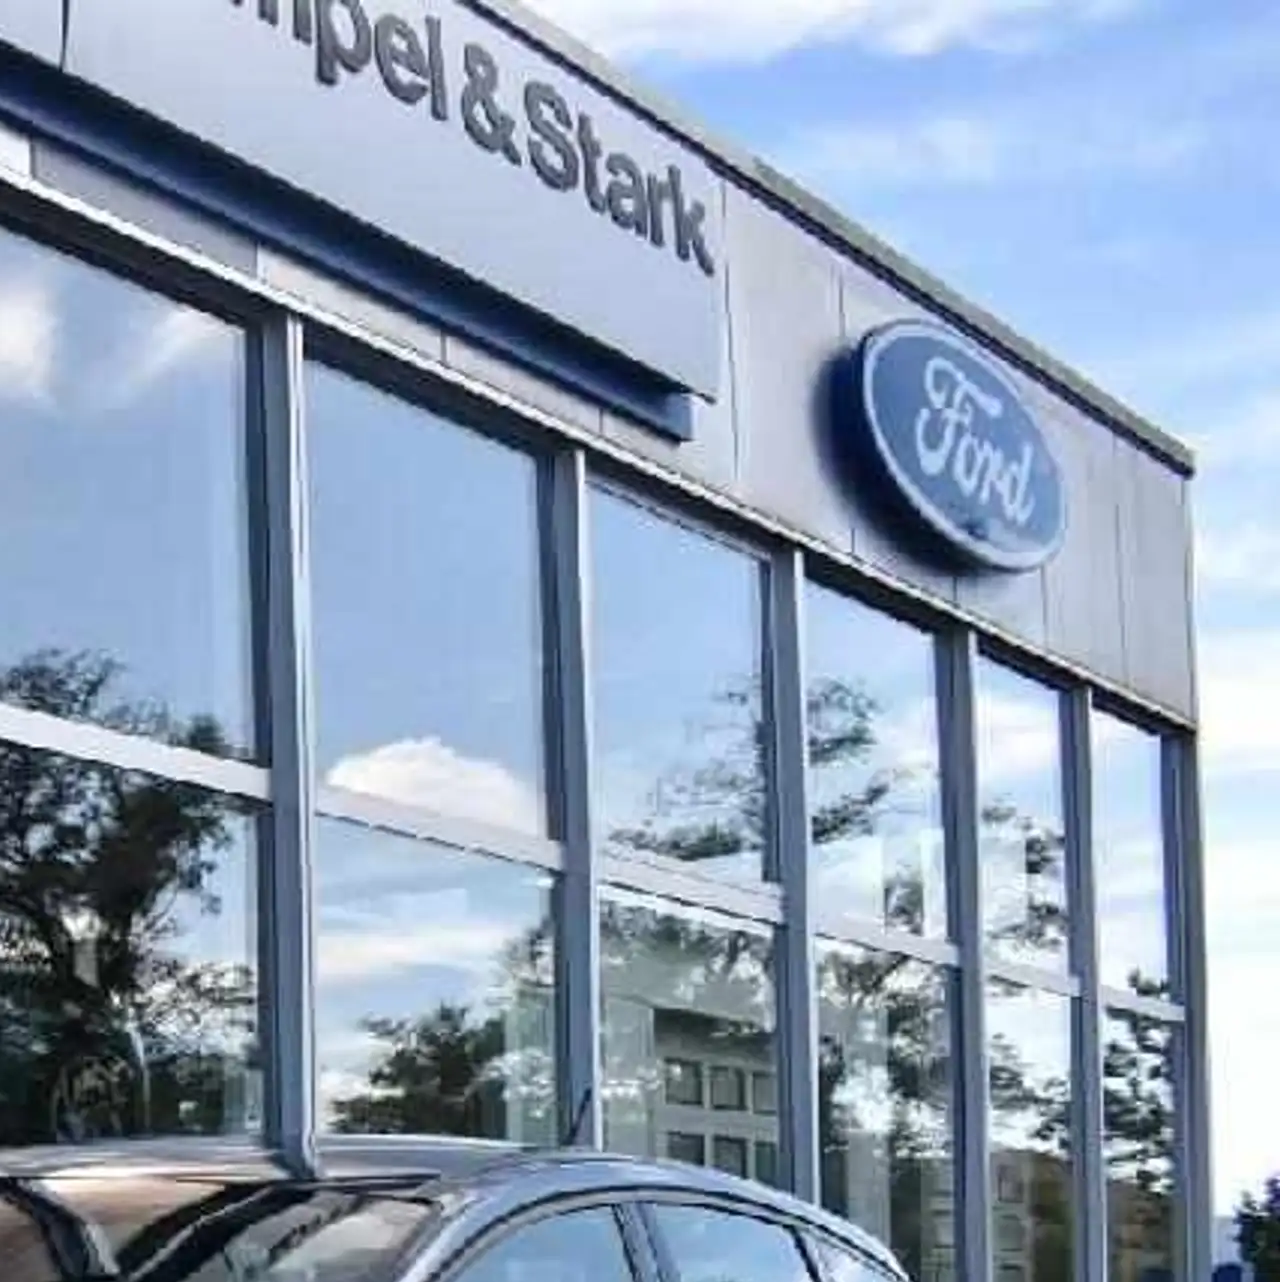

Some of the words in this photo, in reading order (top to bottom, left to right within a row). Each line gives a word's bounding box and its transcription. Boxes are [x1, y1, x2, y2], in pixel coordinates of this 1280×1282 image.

[461, 43, 523, 167] &
[524, 80, 715, 277] Stark
[915, 357, 1037, 526] Ford
